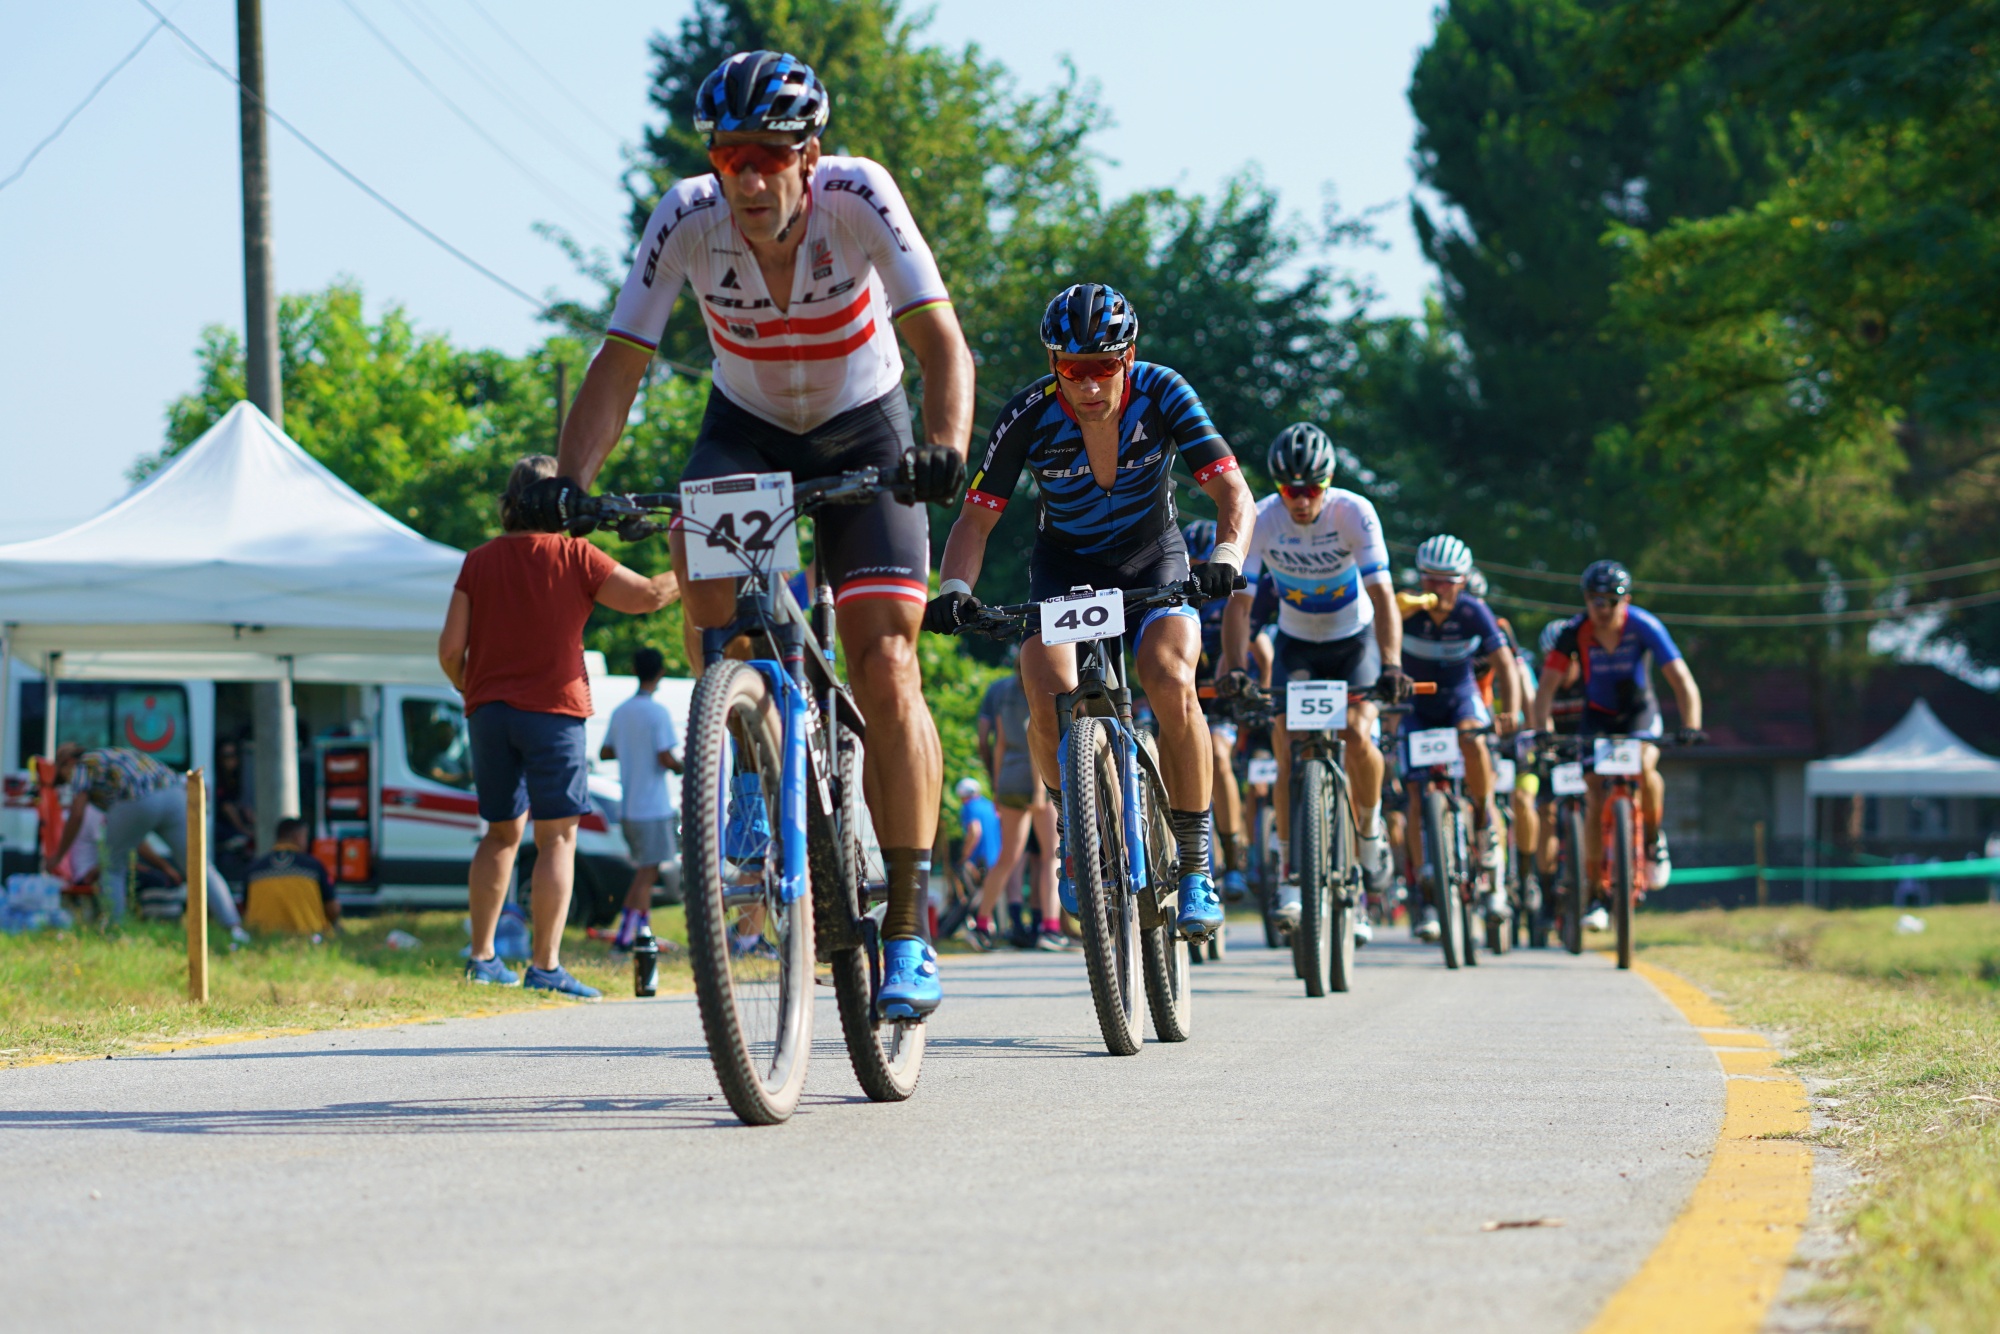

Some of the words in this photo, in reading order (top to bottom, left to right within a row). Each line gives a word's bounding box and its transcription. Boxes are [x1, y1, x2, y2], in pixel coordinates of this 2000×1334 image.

[823, 179, 912, 252] BULLS
[643, 196, 717, 289] BULLS
[983, 389, 1044, 472] BULLS
[689, 484, 711, 495] UCI
[706, 510, 775, 553] 42
[1054, 606, 1109, 630] 40
[1301, 698, 1333, 715] 55
